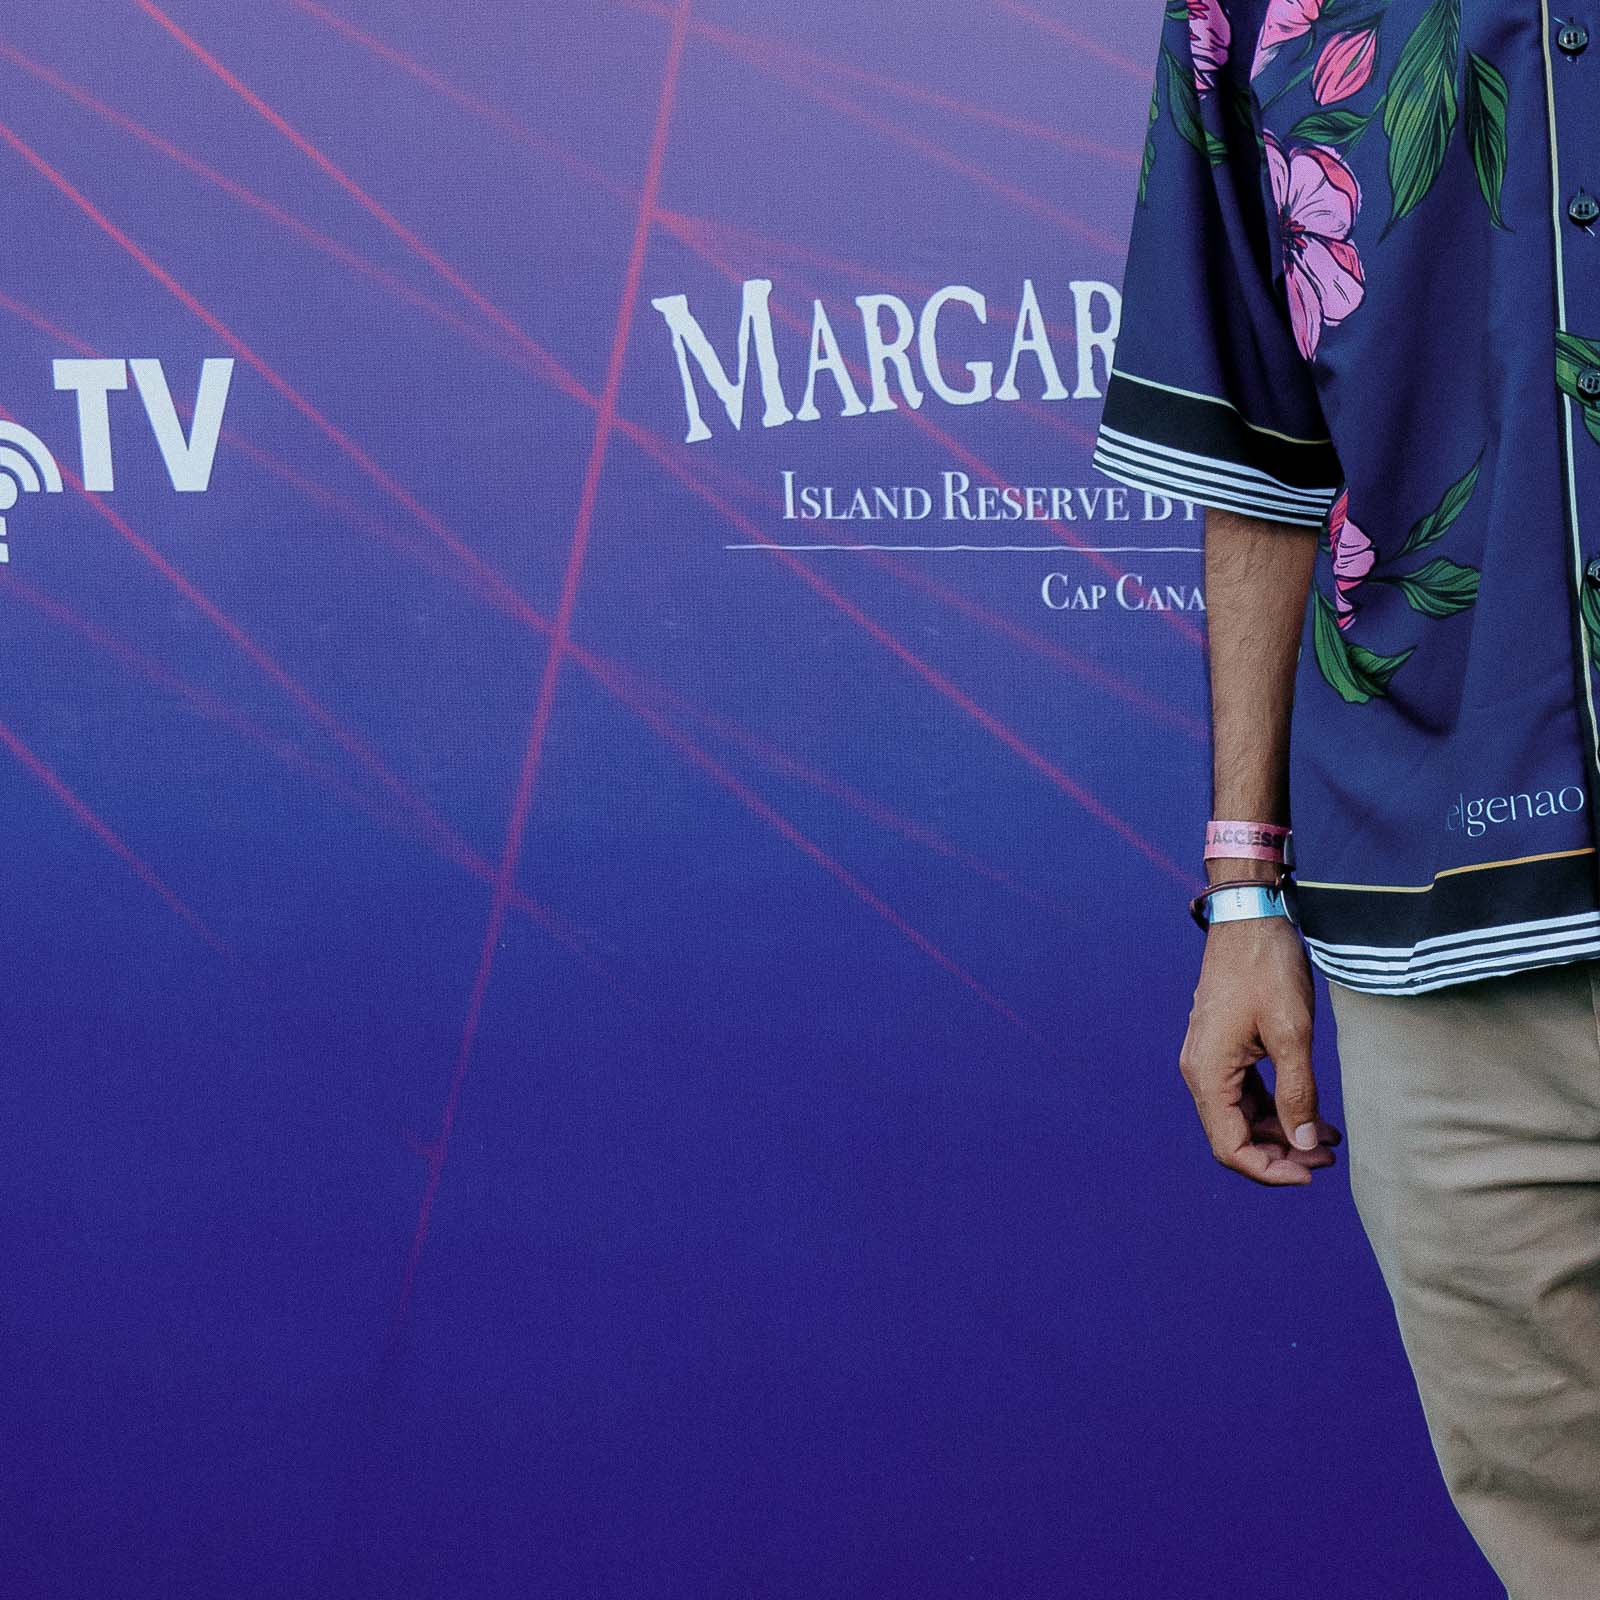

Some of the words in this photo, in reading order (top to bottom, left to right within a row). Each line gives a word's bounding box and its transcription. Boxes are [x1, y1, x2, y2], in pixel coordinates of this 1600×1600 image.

[52, 357, 235, 493] TV
[781, 471, 932, 520] ISLAND
[941, 468, 1130, 521] RESERVE
[1041, 573, 1107, 611] CAP
[1115, 574, 1206, 611] CANA
